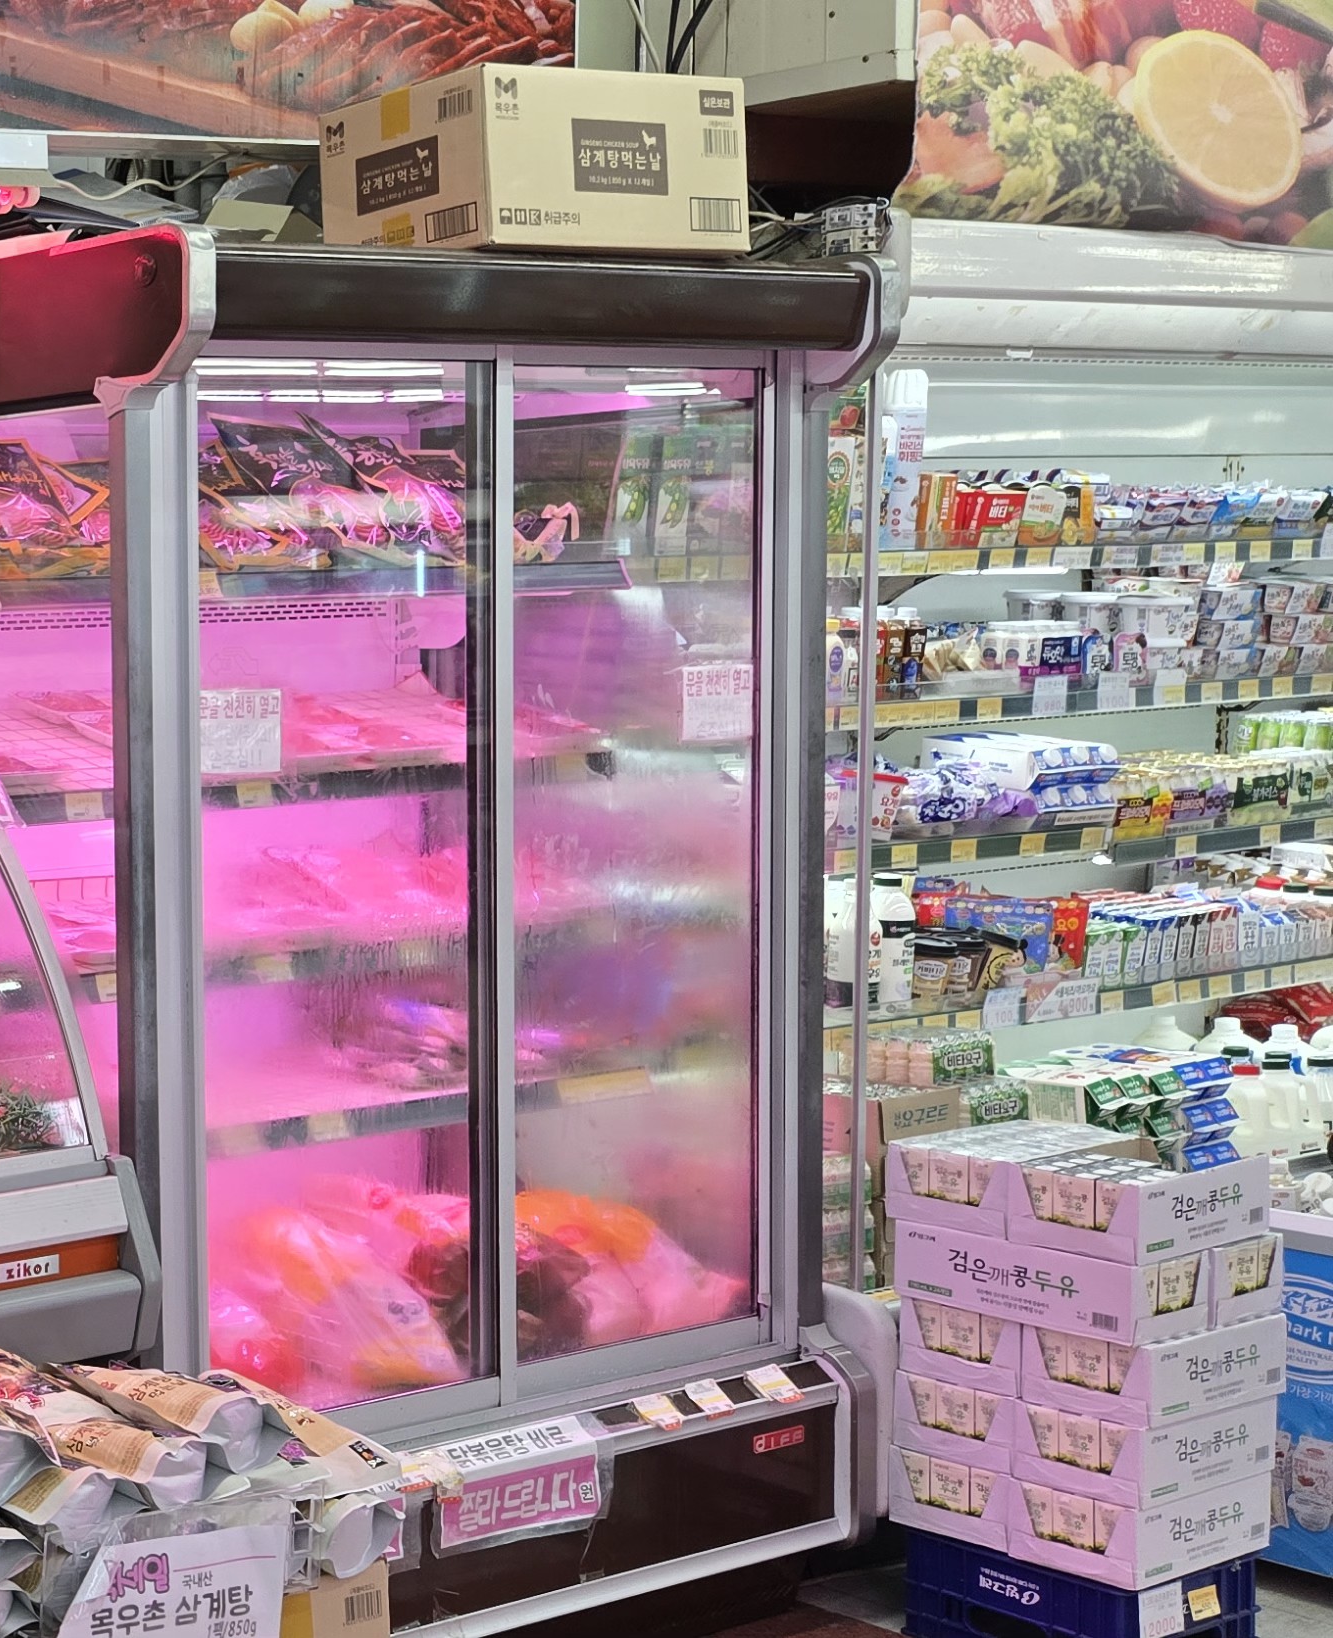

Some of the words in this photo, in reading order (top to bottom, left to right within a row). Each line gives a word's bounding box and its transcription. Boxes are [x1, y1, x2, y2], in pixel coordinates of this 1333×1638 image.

[544, 212, 581, 226] 취급주의
[988, 505, 1008, 518] 버터
[685, 670, 704, 698] 문을
[705, 668, 731, 696] 천천히
[733, 668, 751, 695] 열고
[223, 695, 256, 719] 천천히
[259, 695, 280, 719] 열고
[946, 1050, 983, 1068] 비타요구
[983, 1100, 1018, 1118] 비타요구
[1171, 1182, 1244, 1222] 검은깨콩두유
[948, 1248, 1081, 1299] 검은깨콩두유
[1287, 1320, 1322, 1345] mark
[1184, 1344, 1261, 1383] 검은깨콩두유
[1290, 1382, 1314, 1400] 가장
[447, 1434, 530, 1469] 닭볶음탕
[532, 1424, 574, 1451] 바로
[1174, 1423, 1249, 1464] 검은깨콩두유
[580, 1481, 595, 1502] 원
[1169, 1501, 1245, 1542] 검은깨콩두유
[181, 1571, 214, 1588] 국내산
[90, 1602, 167, 1638] 목우촌
[174, 1585, 255, 1627] 삼계탕
